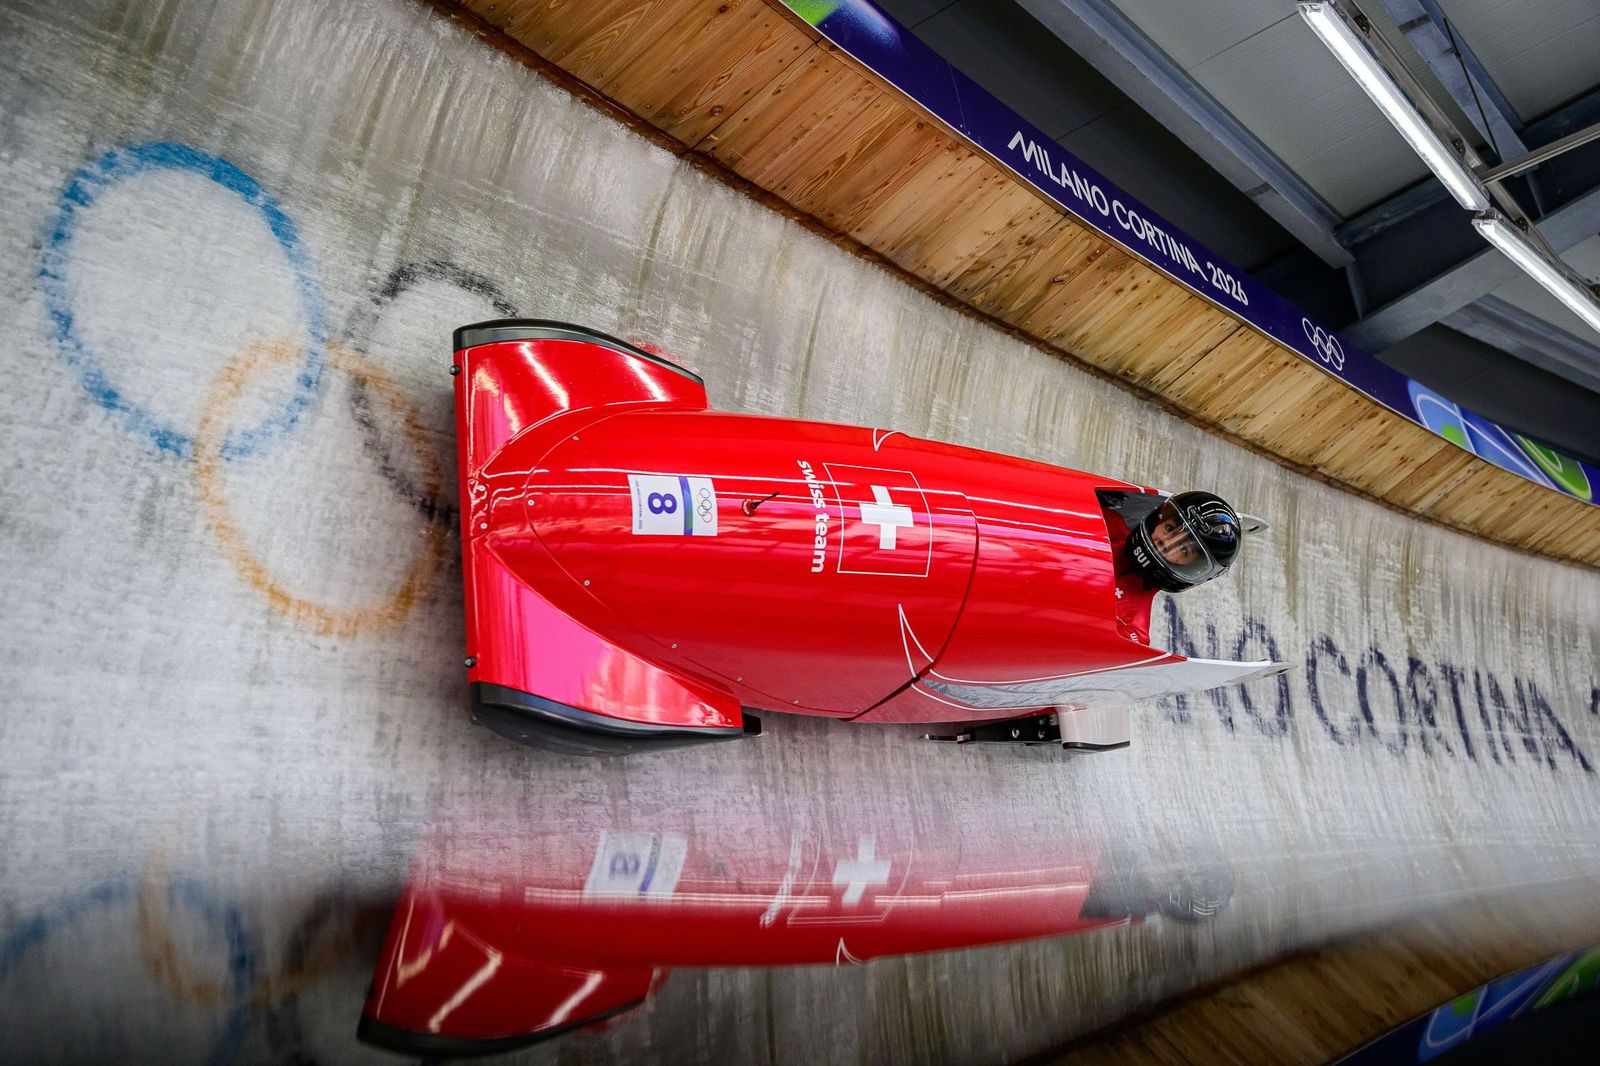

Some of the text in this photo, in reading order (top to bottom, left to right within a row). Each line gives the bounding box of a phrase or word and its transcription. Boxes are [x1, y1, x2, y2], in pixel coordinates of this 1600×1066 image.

[1008, 131, 1249, 305] MILANO CORTINA 2026
[648, 492, 677, 514] 8
[797, 460, 830, 572] swiss team
[1134, 546, 1150, 567] SUI
[1306, 634, 1594, 773] CORTINA
